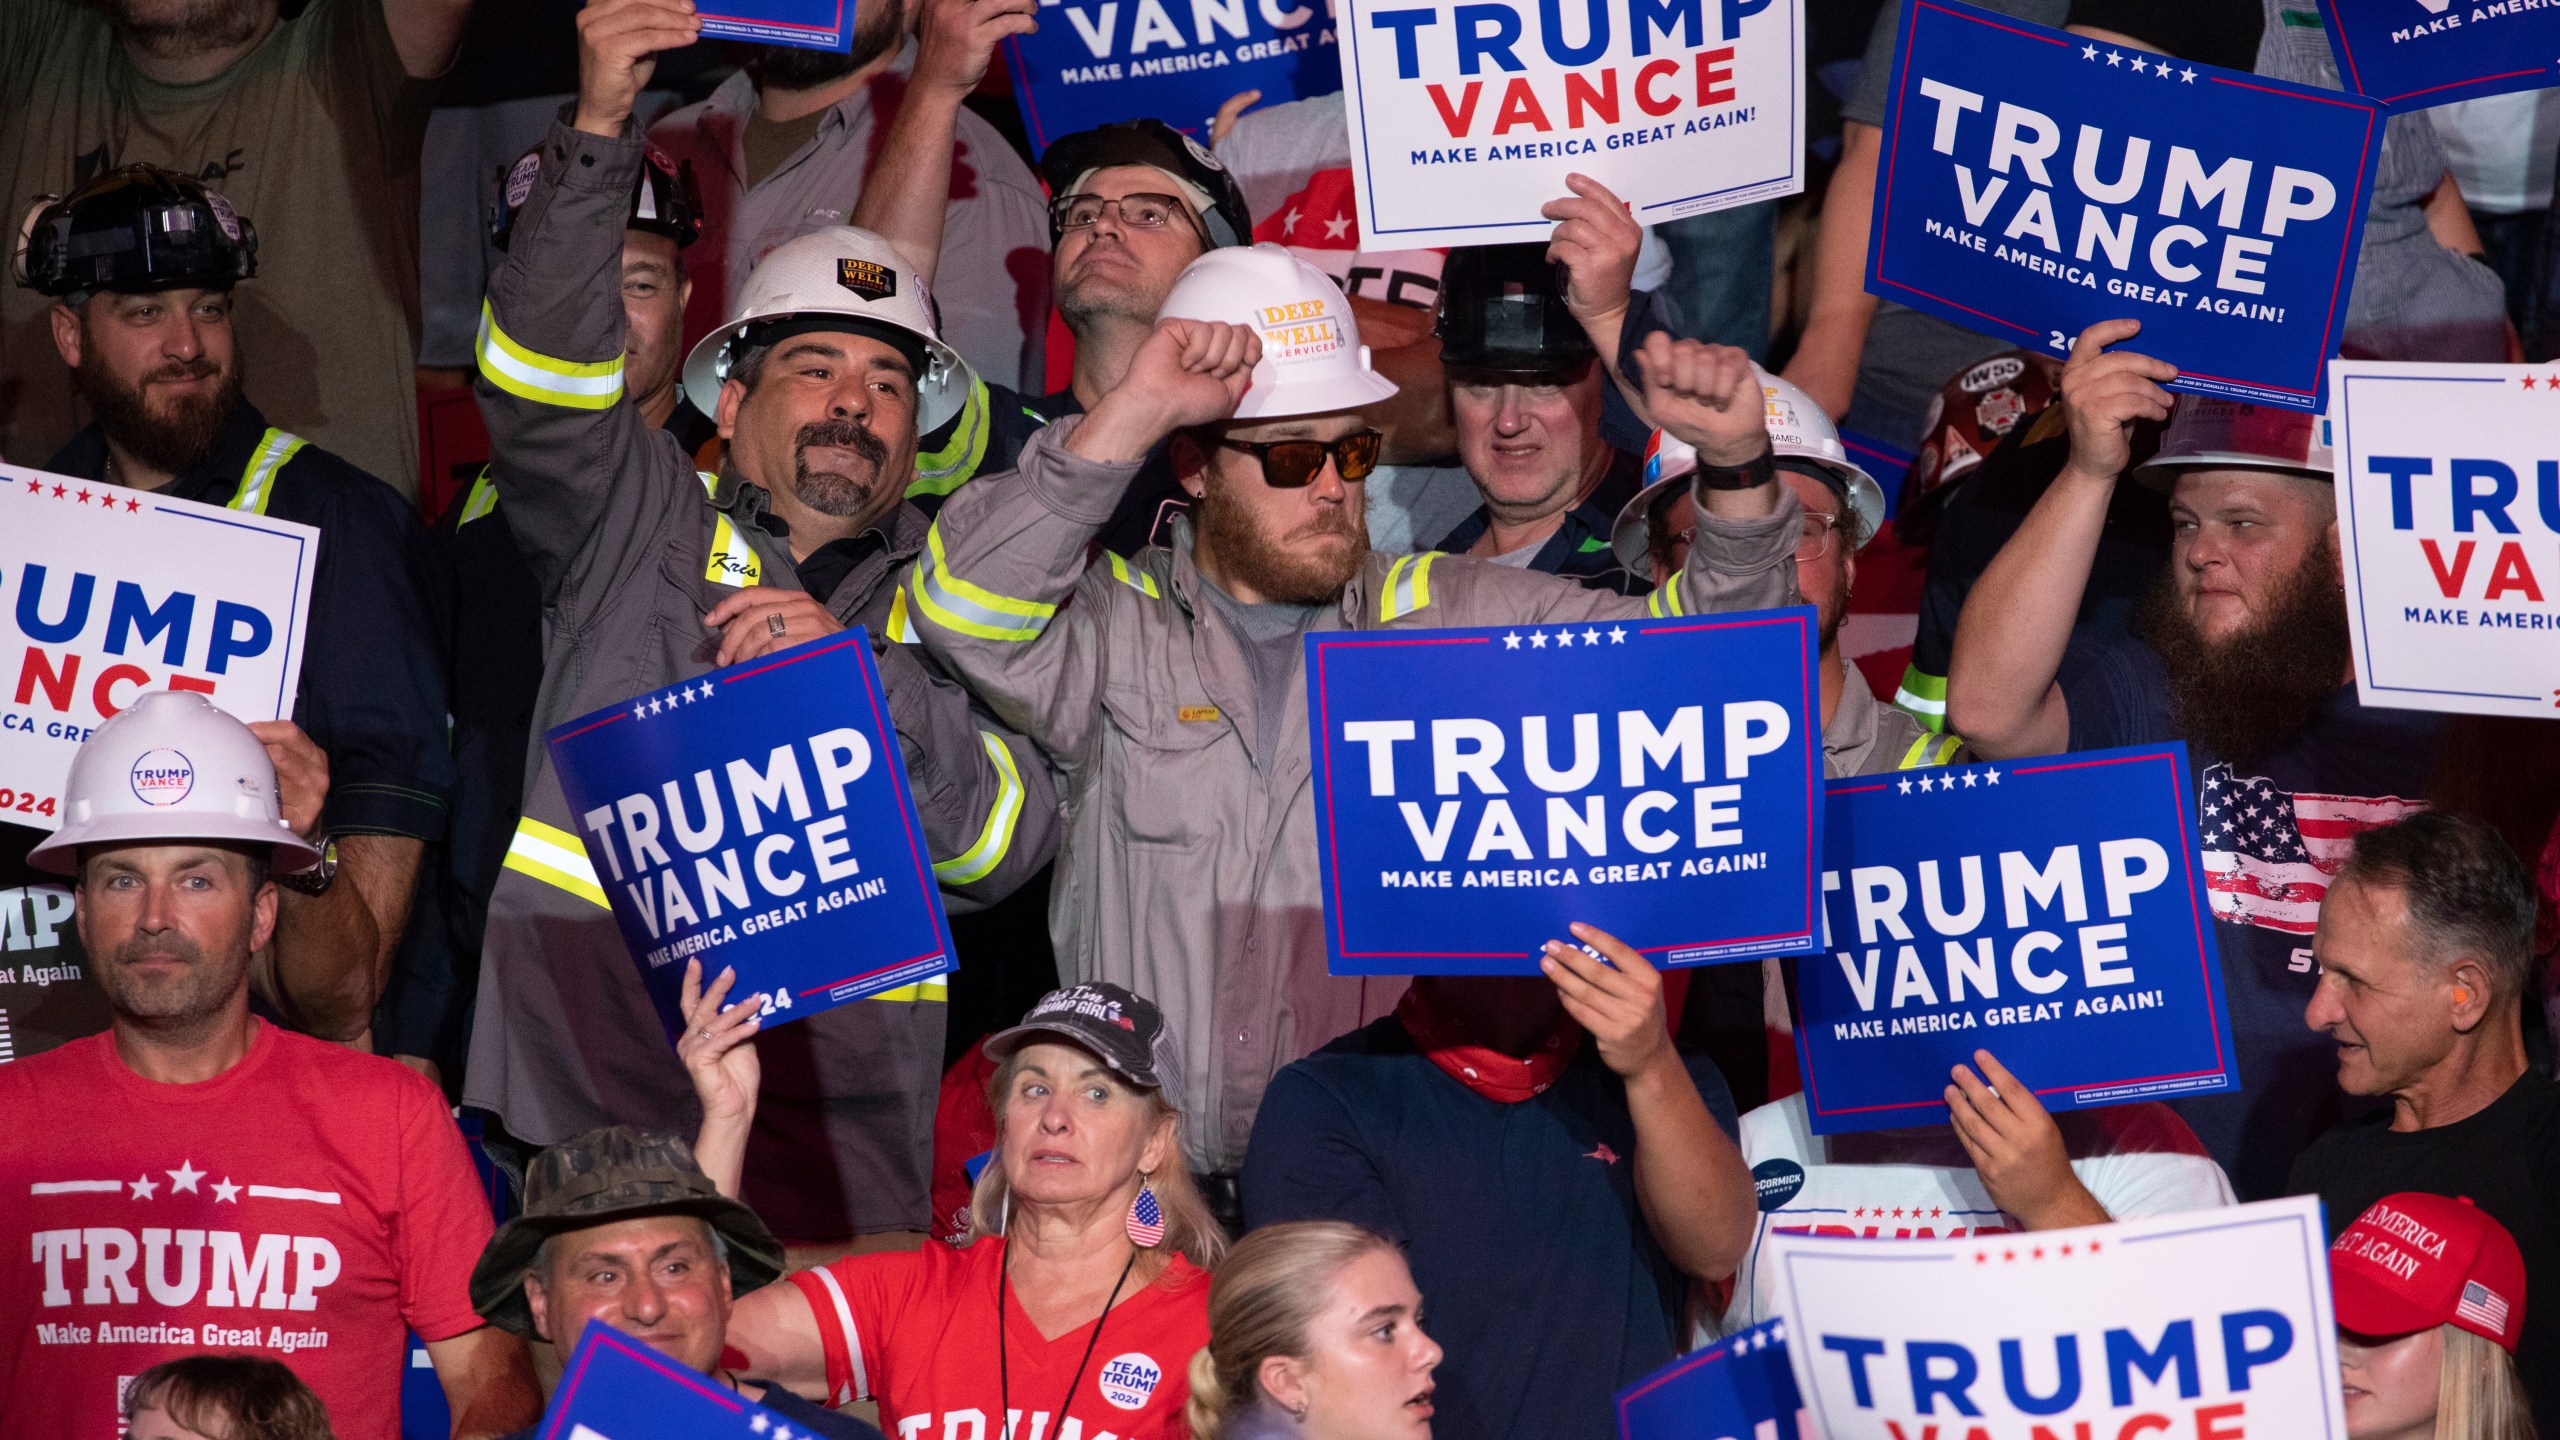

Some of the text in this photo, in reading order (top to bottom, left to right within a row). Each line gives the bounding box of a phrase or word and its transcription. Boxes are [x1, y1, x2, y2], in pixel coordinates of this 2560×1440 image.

[1065, 0, 1335, 59] VANC
[1371, 0, 1773, 79] TRUMP
[2391, 14, 2462, 44] MAKE
[1061, 64, 1123, 85] MAKE
[1130, 50, 1229, 78] AMERICA
[1236, 33, 1309, 62] GREAT
[1425, 46, 1736, 138] VANCE
[1411, 106, 1756, 165] MAKE AMERICA GREAT AGAIN!
[512, 160, 537, 176] TEAM
[1920, 77, 2337, 237] TRUMP
[507, 171, 536, 188] TRUMP
[510, 191, 526, 202] 2024
[1954, 164, 2273, 296] VANCE
[844, 270, 883, 285] WELL
[847, 260, 883, 273] DEEP
[1925, 218, 2285, 324] MAKE AMERICA GREAT AGAIN!
[1263, 299, 1324, 324] DEEP
[1265, 323, 1334, 347] WELL
[1276, 343, 1336, 358] SERVICES
[2202, 382, 2224, 390] DONALD
[2258, 391, 2285, 400] PRESIDENT
[711, 552, 758, 578] Kris
[2419, 538, 2560, 602] VA
[0, 563, 273, 675] UMP
[2404, 607, 2469, 625] MAKE
[1344, 700, 1791, 796] TRUMP
[134, 769, 191, 780] TRUMP
[140, 778, 184, 787] VANCE
[584, 728, 872, 882] TRUMP
[1398, 784, 1743, 861] VANCE
[628, 815, 860, 940] VANCE
[1381, 852, 1767, 887] MAKE AMERICA GREAT AGAIN!
[648, 877, 887, 968] MAKE AMERICA GREAT AGAIN!
[23, 962, 82, 986] Again
[1837, 923, 2135, 1011] VANCE
[1032, 999, 1107, 1021] TRUMP GIRL
[1834, 990, 2164, 1040] MAKE AMERICA GREAT AGAIN!
[1755, 1174, 1801, 1191] CCORMICK
[1765, 1186, 1793, 1196] SENATE
[2361, 1204, 2448, 1260] AMERICA
[32, 1227, 341, 1311] TRUMP
[2361, 1236, 2421, 1281] AGAIN
[36, 1322, 328, 1354] Make America Great Again
[1112, 1361, 1159, 1381] TEAM
[1821, 1309, 2295, 1417] TRUMP
[1110, 1391, 1140, 1405] 2024
